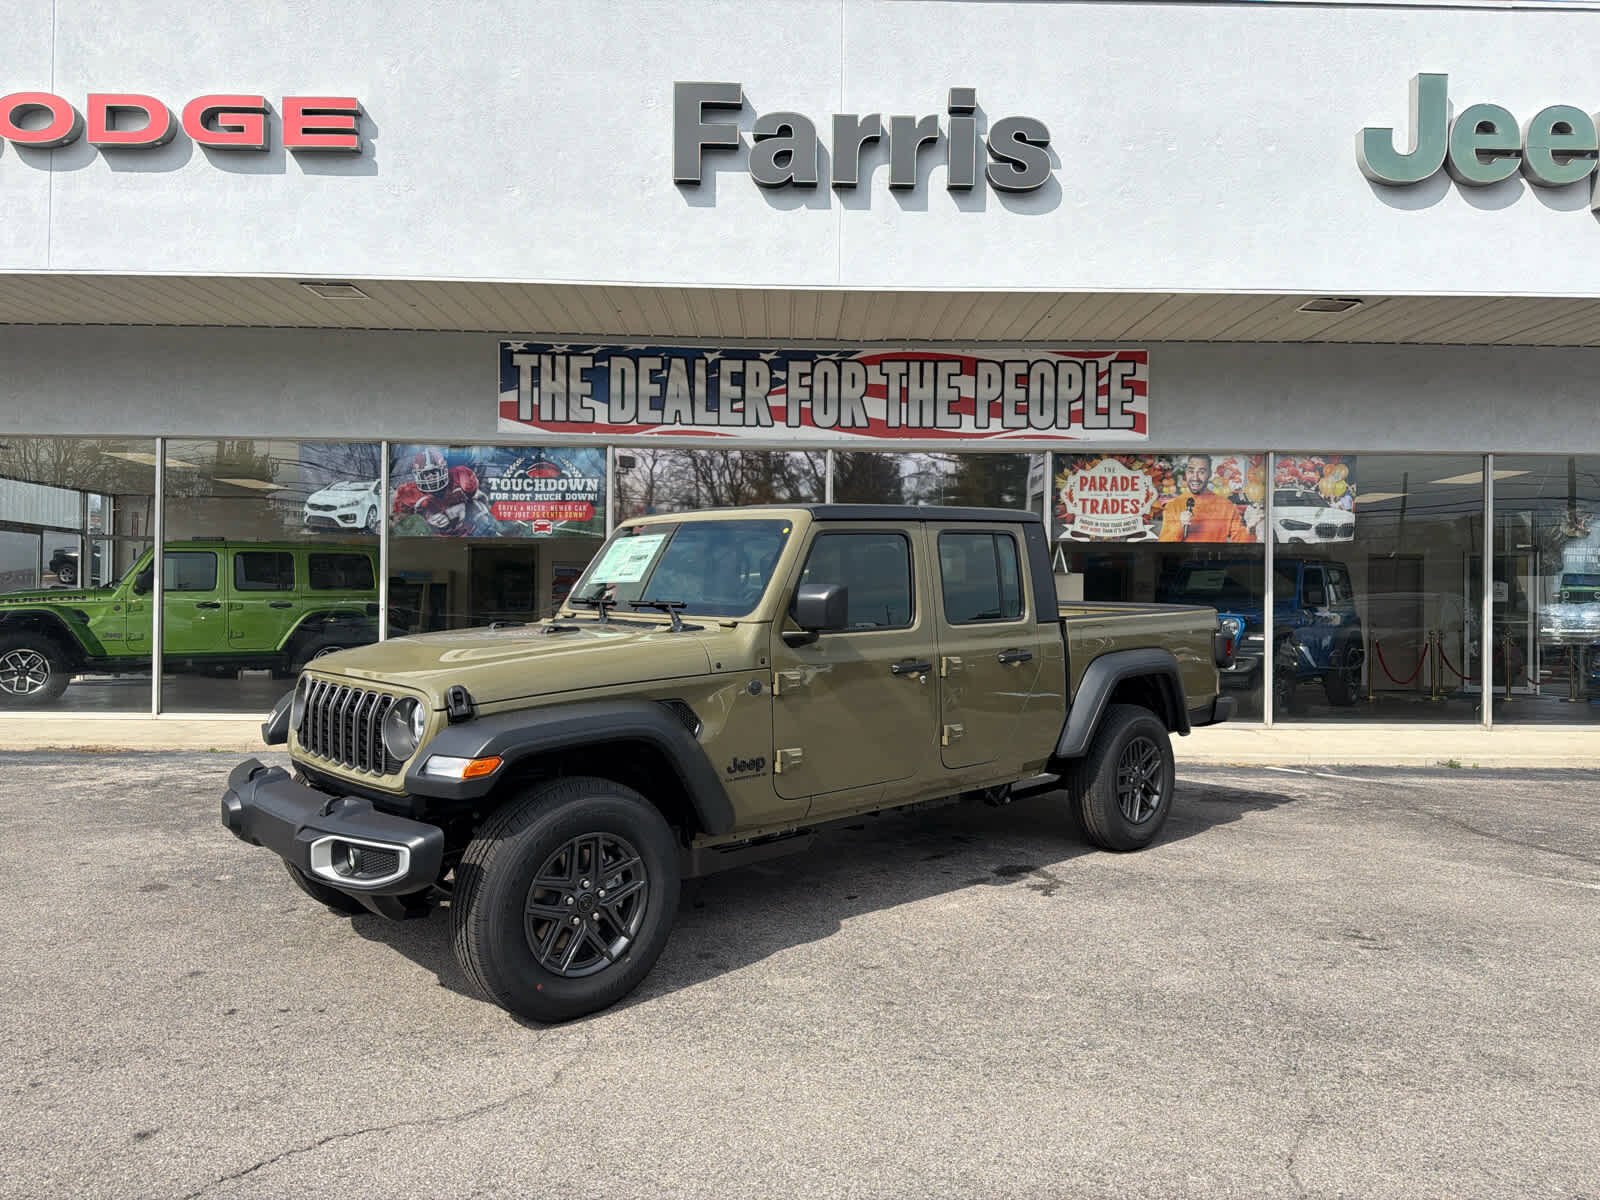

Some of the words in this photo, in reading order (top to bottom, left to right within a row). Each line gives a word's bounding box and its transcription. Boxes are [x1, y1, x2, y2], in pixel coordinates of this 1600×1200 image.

[673, 81, 1052, 193] Farris
[1355, 72, 1600, 212] Jee
[512, 352, 597, 423] THE
[608, 354, 775, 428] DEALER
[784, 359, 870, 429] FOR
[880, 358, 963, 429] THE
[974, 359, 1137, 431] PEOPLE
[488, 478, 599, 491] TOUCHDOWN
[1079, 475, 1140, 492] PARADE
[511, 493, 532, 501] NOT
[535, 493, 562, 501] MUCH
[565, 493, 598, 501] DOWN!
[1079, 498, 1140, 514] TRADES
[727, 757, 766, 773] Jeep
